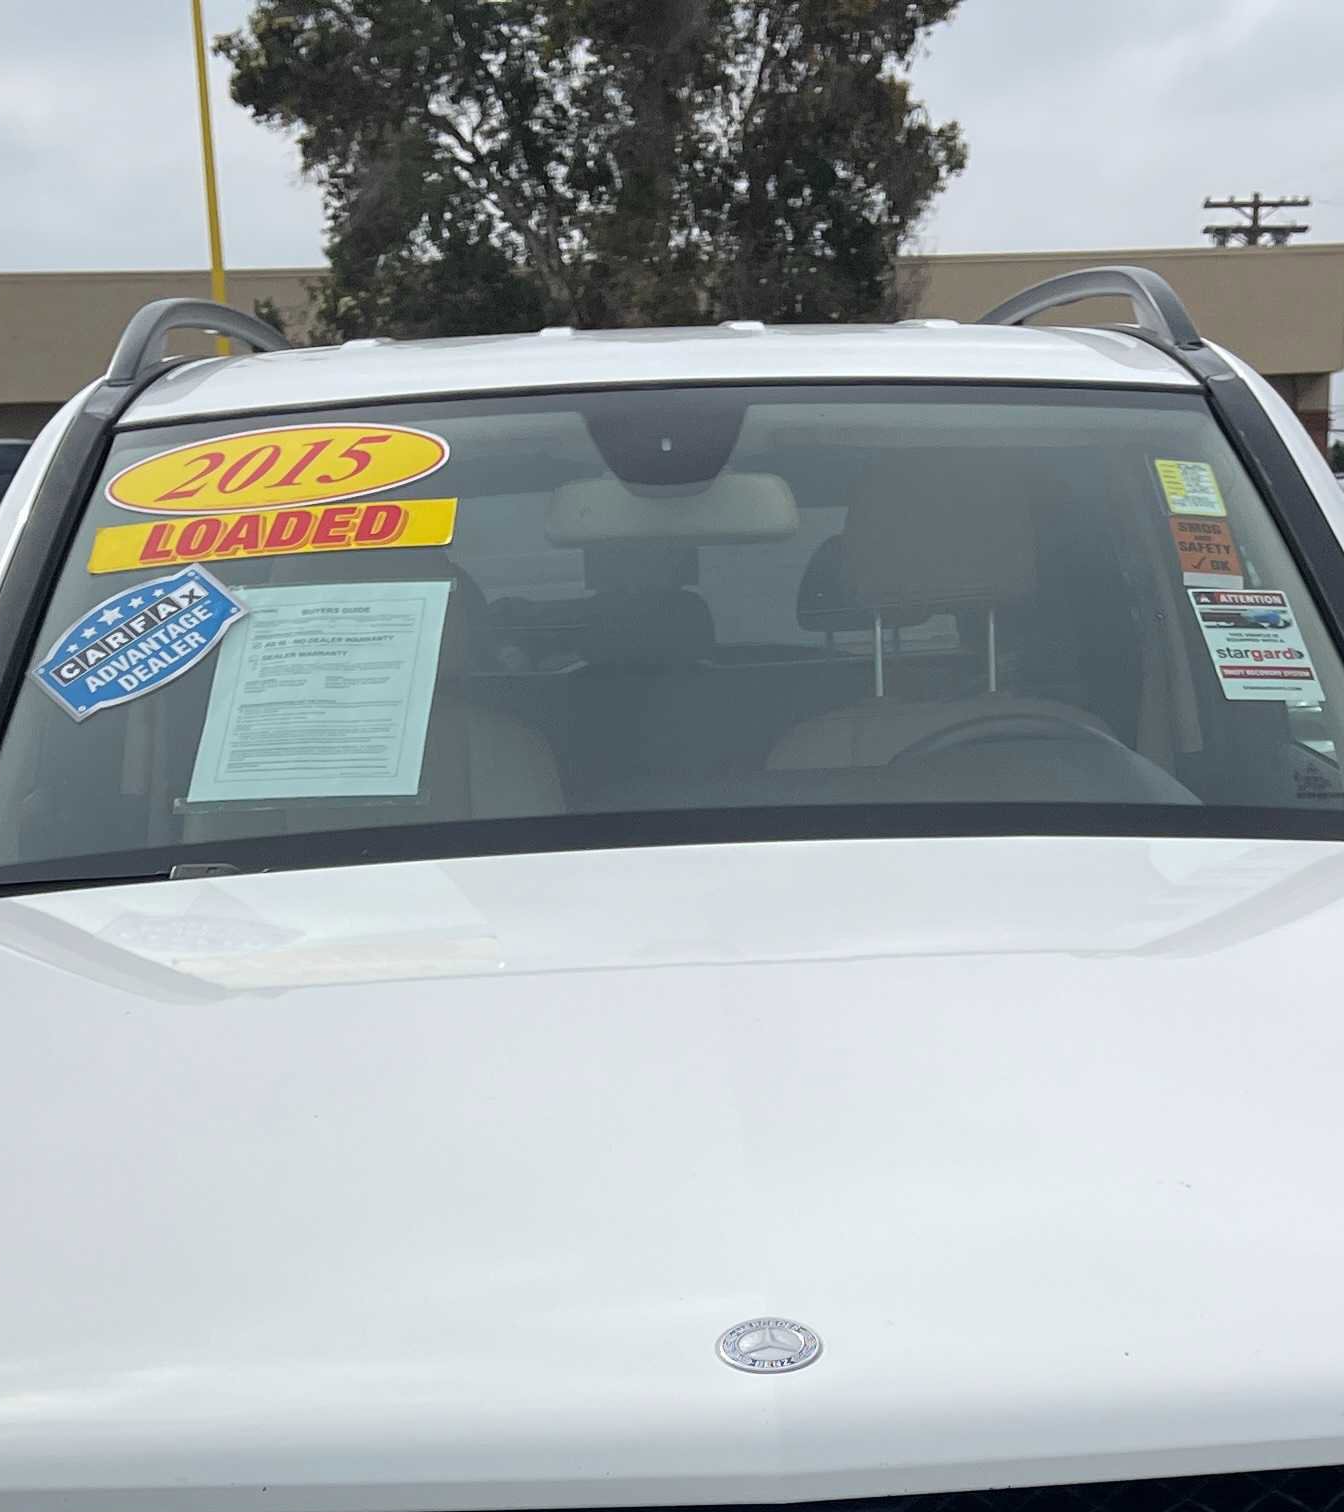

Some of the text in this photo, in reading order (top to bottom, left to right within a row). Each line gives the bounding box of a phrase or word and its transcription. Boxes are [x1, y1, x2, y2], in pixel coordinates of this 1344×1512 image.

[153, 434, 394, 503] 2015
[139, 503, 409, 564] LOADED
[1178, 541, 1232, 554] SAFETY
[1219, 593, 1284, 605] ATTENTION
[58, 587, 204, 681] CARFAX
[85, 603, 214, 693] ADVANTAGE
[117, 630, 208, 692] DEALER
[1216, 647, 1295, 661] stargard
